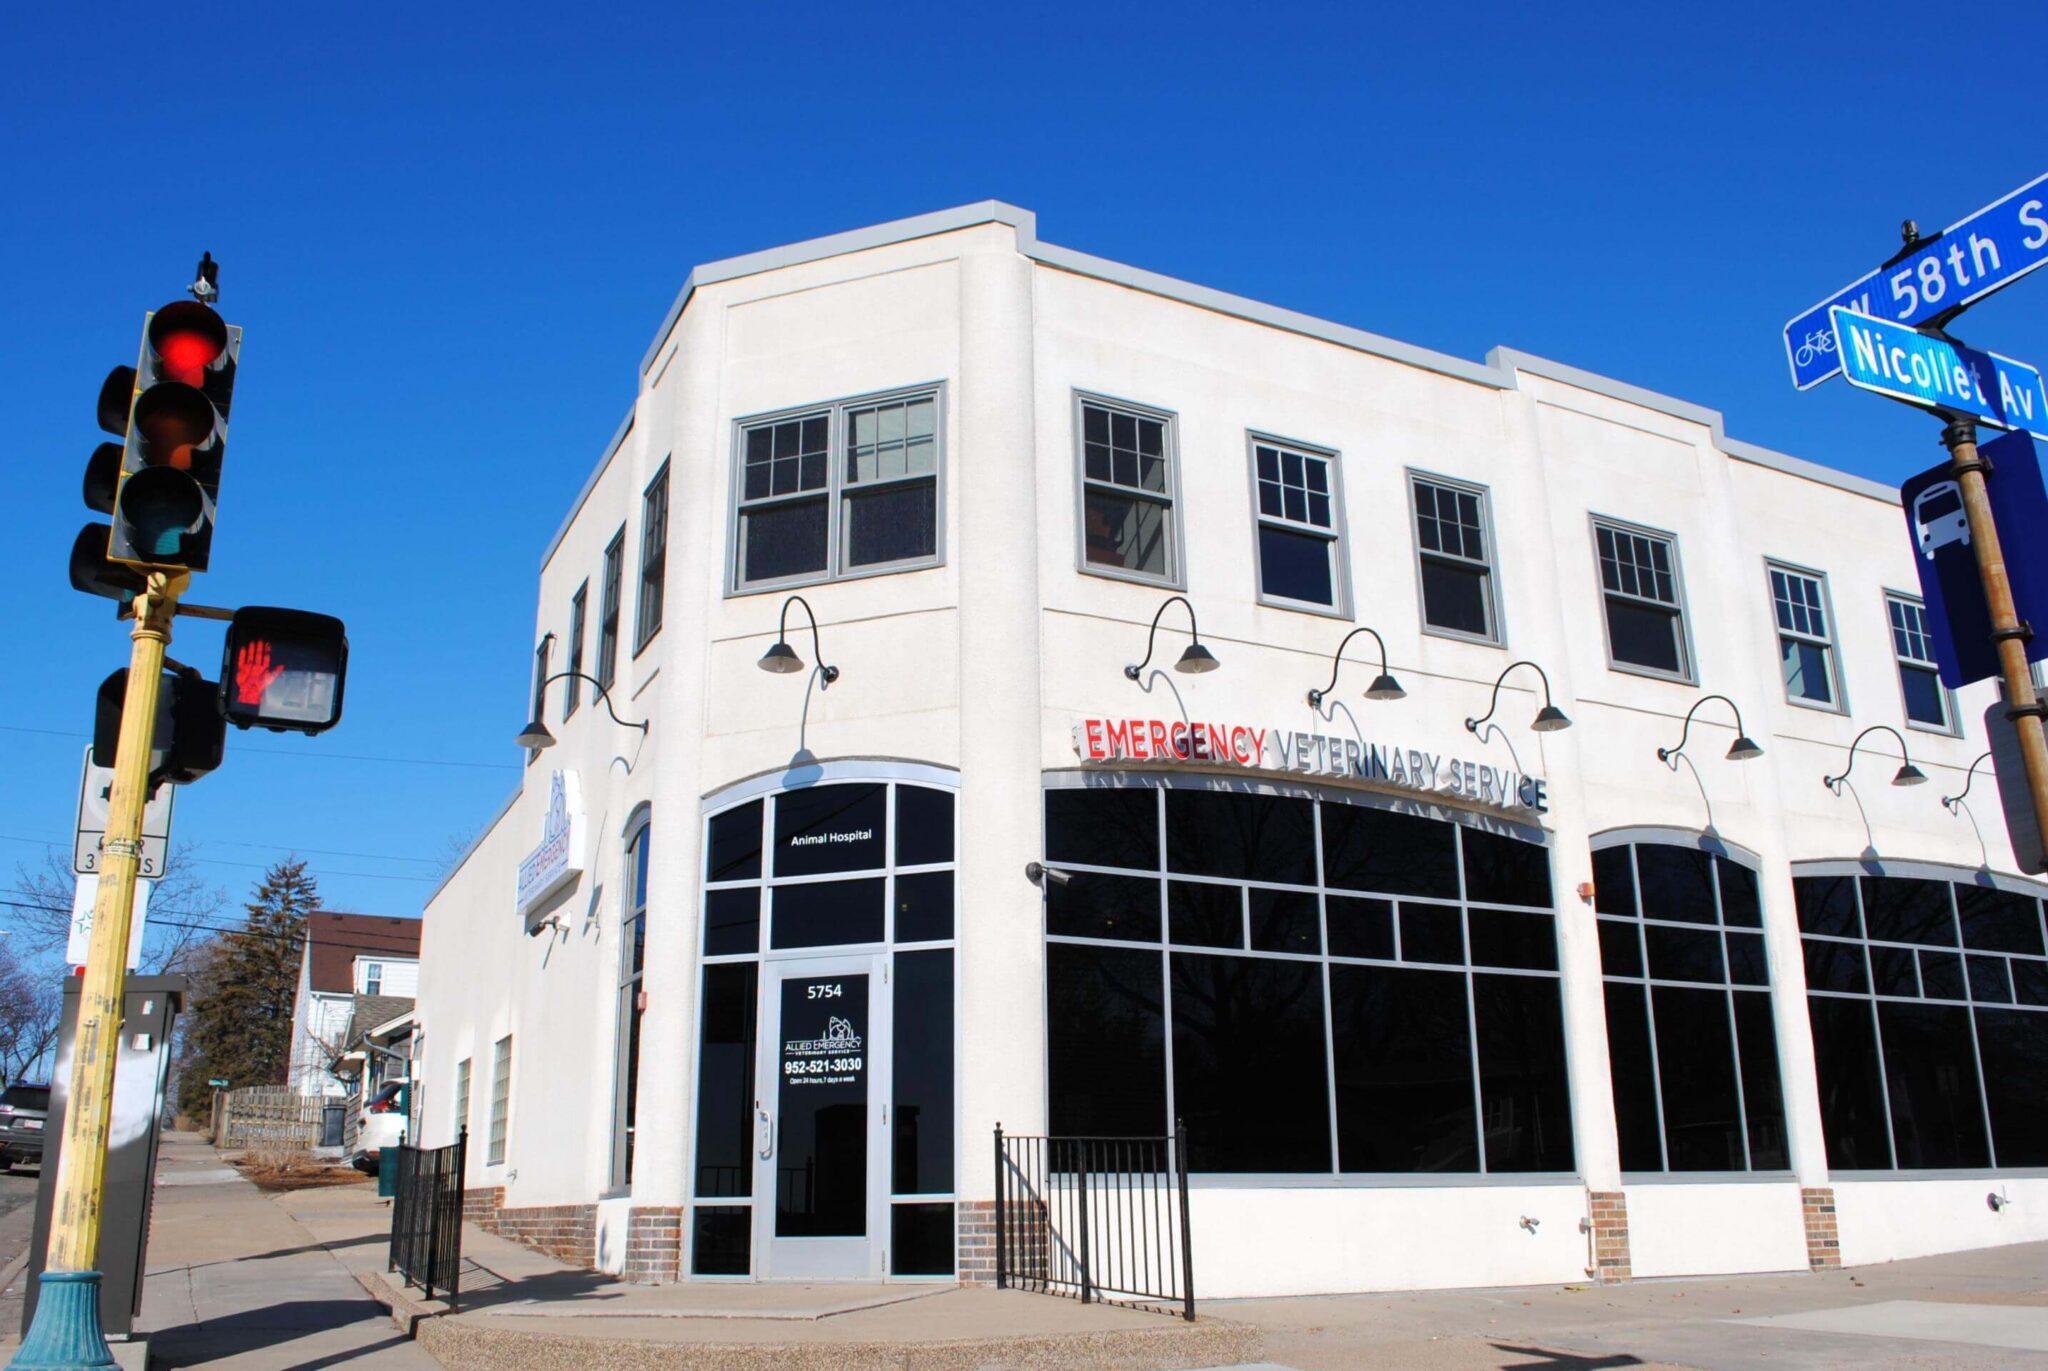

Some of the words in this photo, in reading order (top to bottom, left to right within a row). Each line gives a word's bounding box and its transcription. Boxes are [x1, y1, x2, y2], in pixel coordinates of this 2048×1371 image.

[1891, 233, 2001, 320] 58th
[2019, 200, 2048, 249] S
[1850, 324, 1987, 406] Nicollet
[1999, 369, 2032, 420] Av
[1085, 719, 1266, 764] EMERGENCY
[1275, 729, 1440, 790] VETERINARY
[1450, 758, 1548, 813] SERVICE
[791, 833, 827, 846] Animal
[829, 828, 872, 843] Hospital
[85, 853, 95, 870] 3
[807, 984, 842, 999] 5754
[785, 1042, 812, 1051] ALLIED
[813, 1040, 862, 1050] EMERGENCY
[785, 1057, 862, 1075] 952-521-3030
